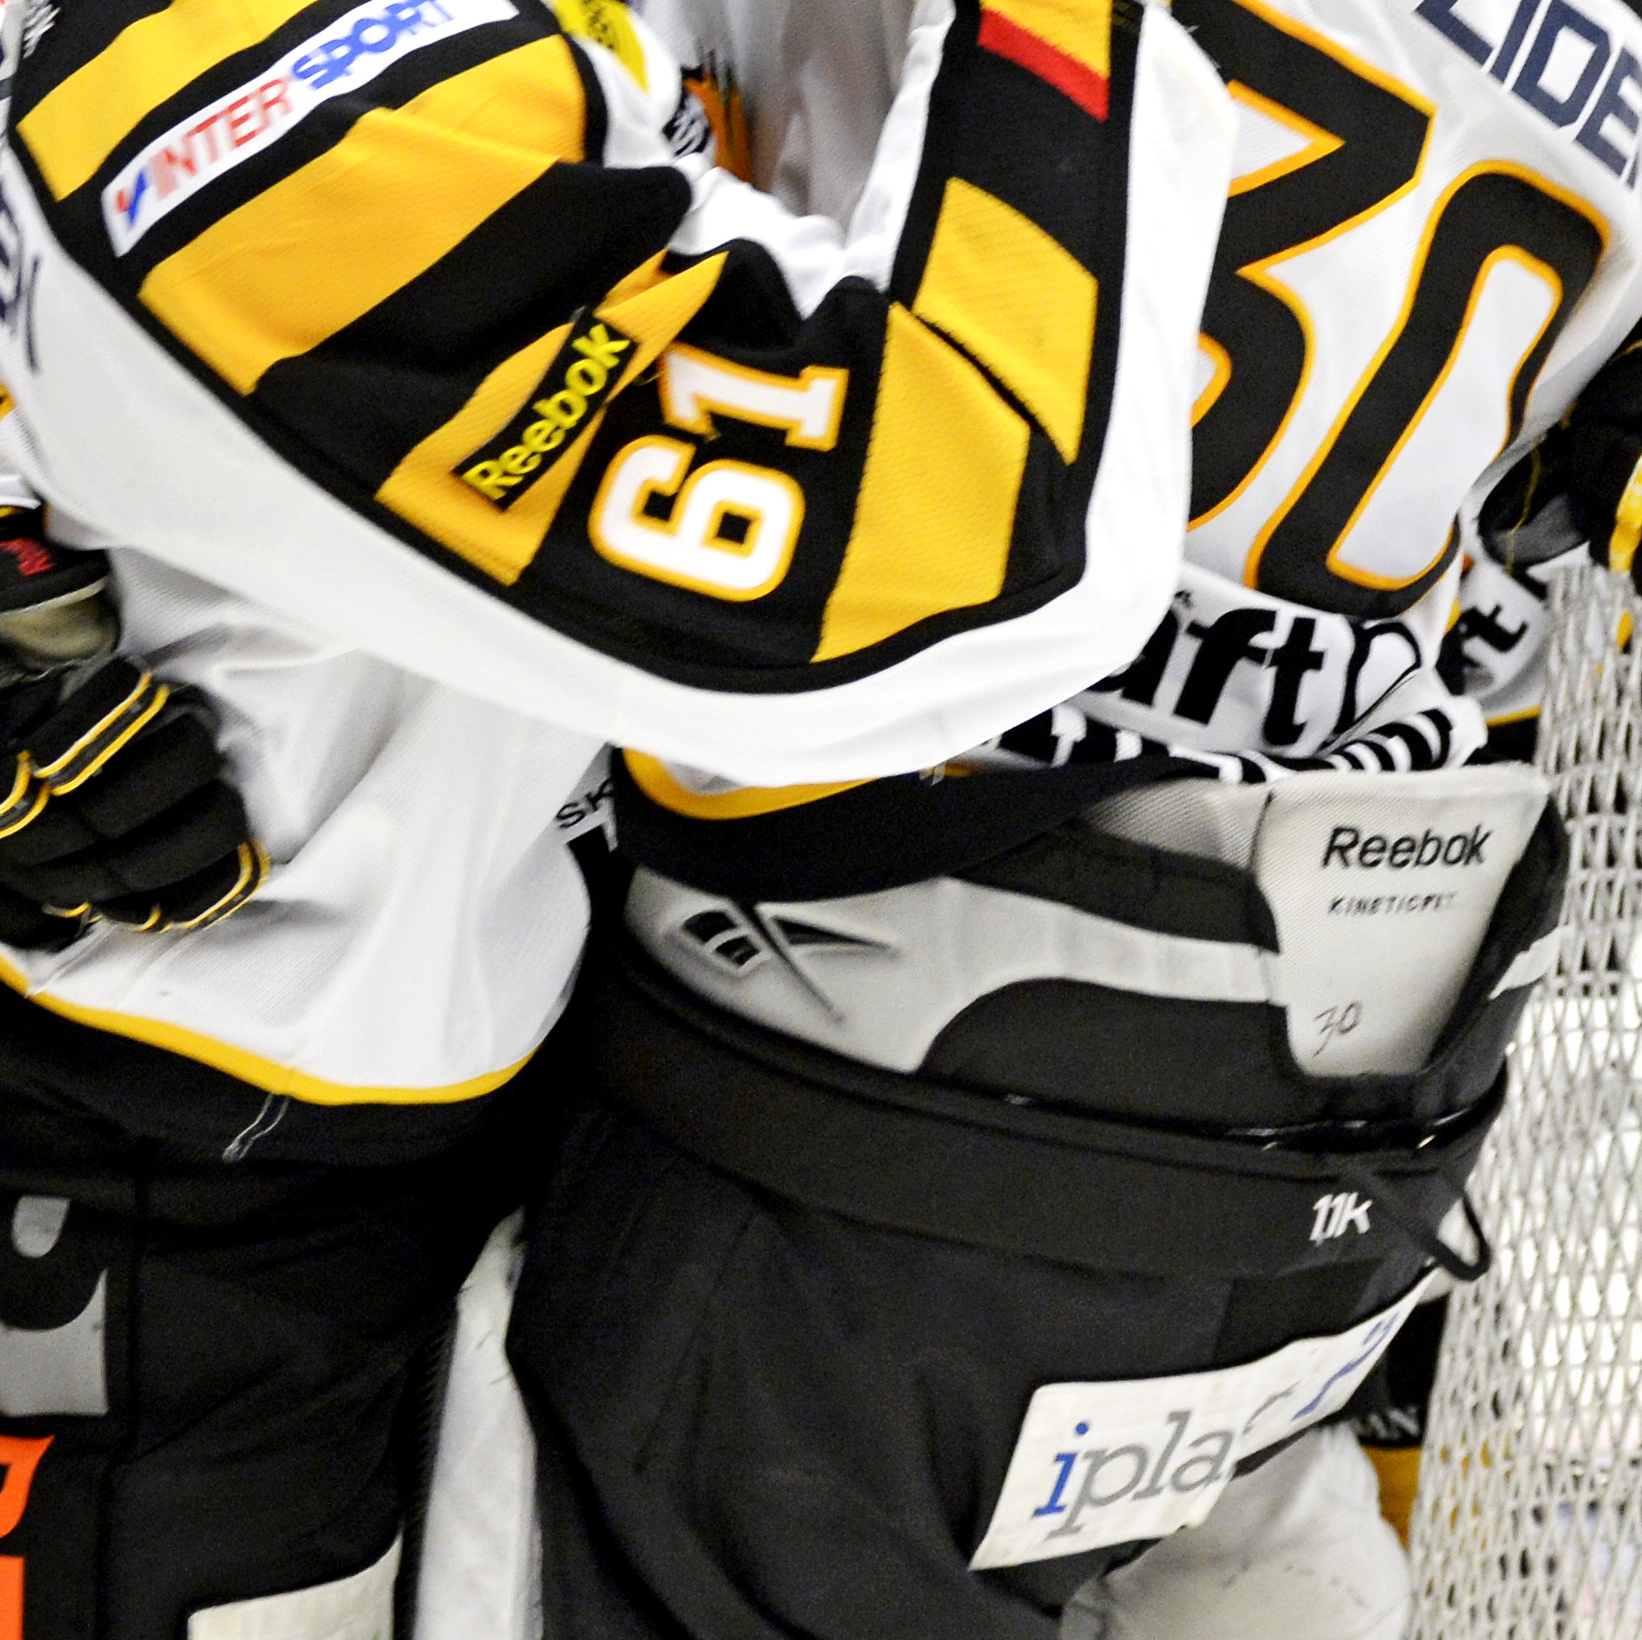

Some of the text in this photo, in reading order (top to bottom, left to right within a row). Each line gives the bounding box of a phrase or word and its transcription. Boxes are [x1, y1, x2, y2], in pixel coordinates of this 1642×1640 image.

[460, 320, 633, 502] Reebok
[587, 340, 851, 604] 61
[1320, 823, 1493, 871] Reebok
